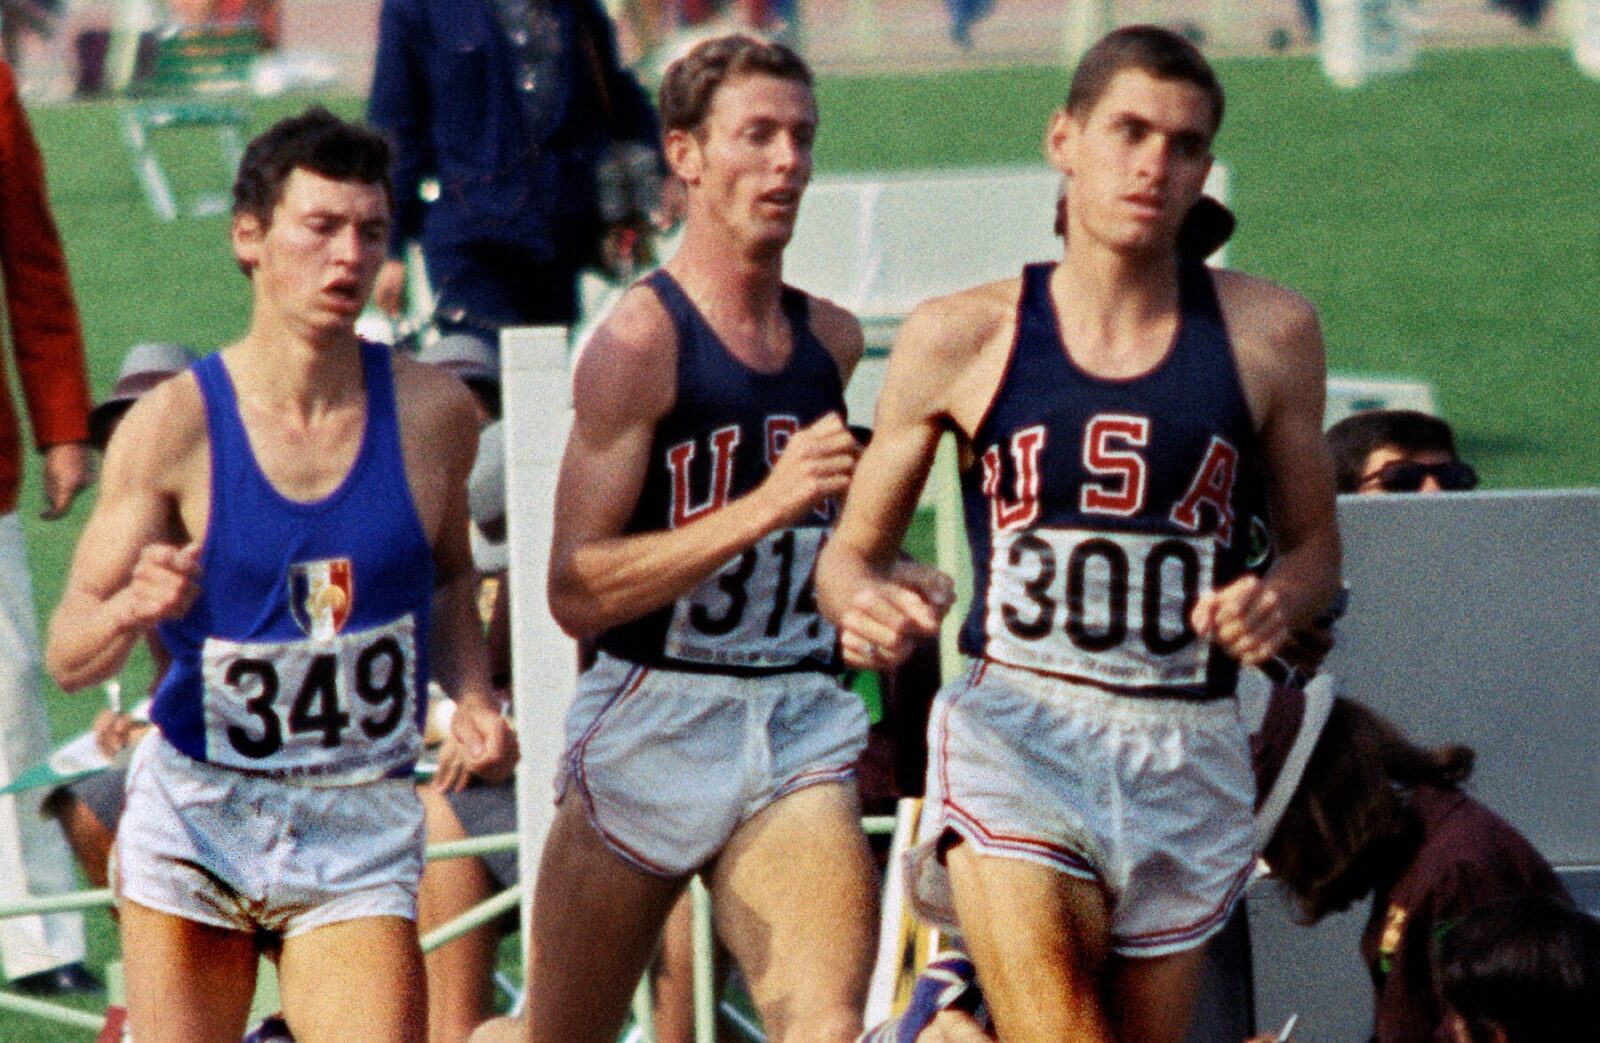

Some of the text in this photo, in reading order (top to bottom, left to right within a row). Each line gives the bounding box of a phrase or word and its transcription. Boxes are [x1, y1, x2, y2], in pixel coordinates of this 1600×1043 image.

[981, 414, 1238, 548] USA
[1001, 534, 1201, 655] 300
[224, 636, 406, 759] 349
